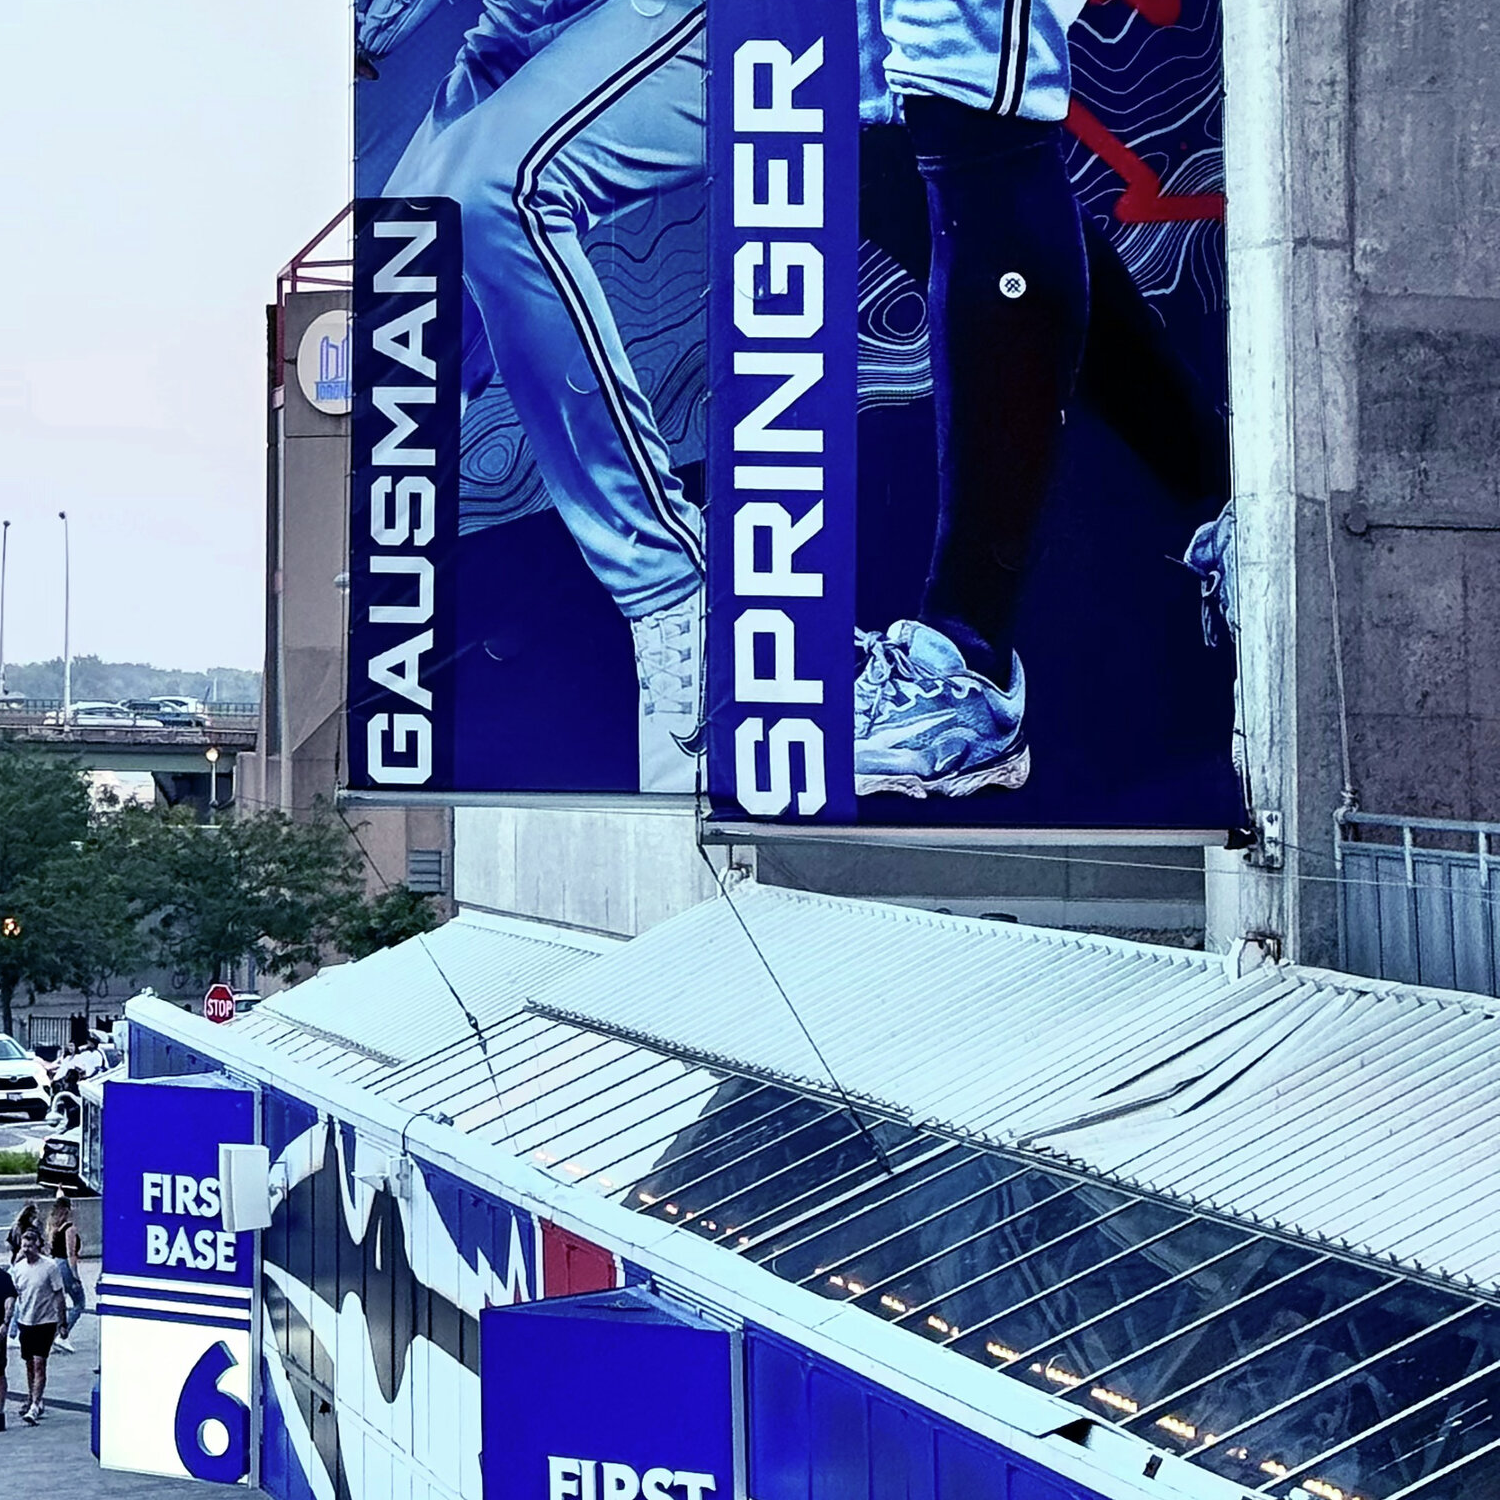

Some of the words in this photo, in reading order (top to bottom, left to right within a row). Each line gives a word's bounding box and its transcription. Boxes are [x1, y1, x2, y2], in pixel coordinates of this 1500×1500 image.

[733, 35, 826, 817] SPRINGER
[367, 220, 440, 785] GAUSMAN
[207, 998, 233, 1017] STOP
[142, 1172, 221, 1218] FIRS
[146, 1224, 238, 1273] BASE
[174, 1340, 250, 1484] 6
